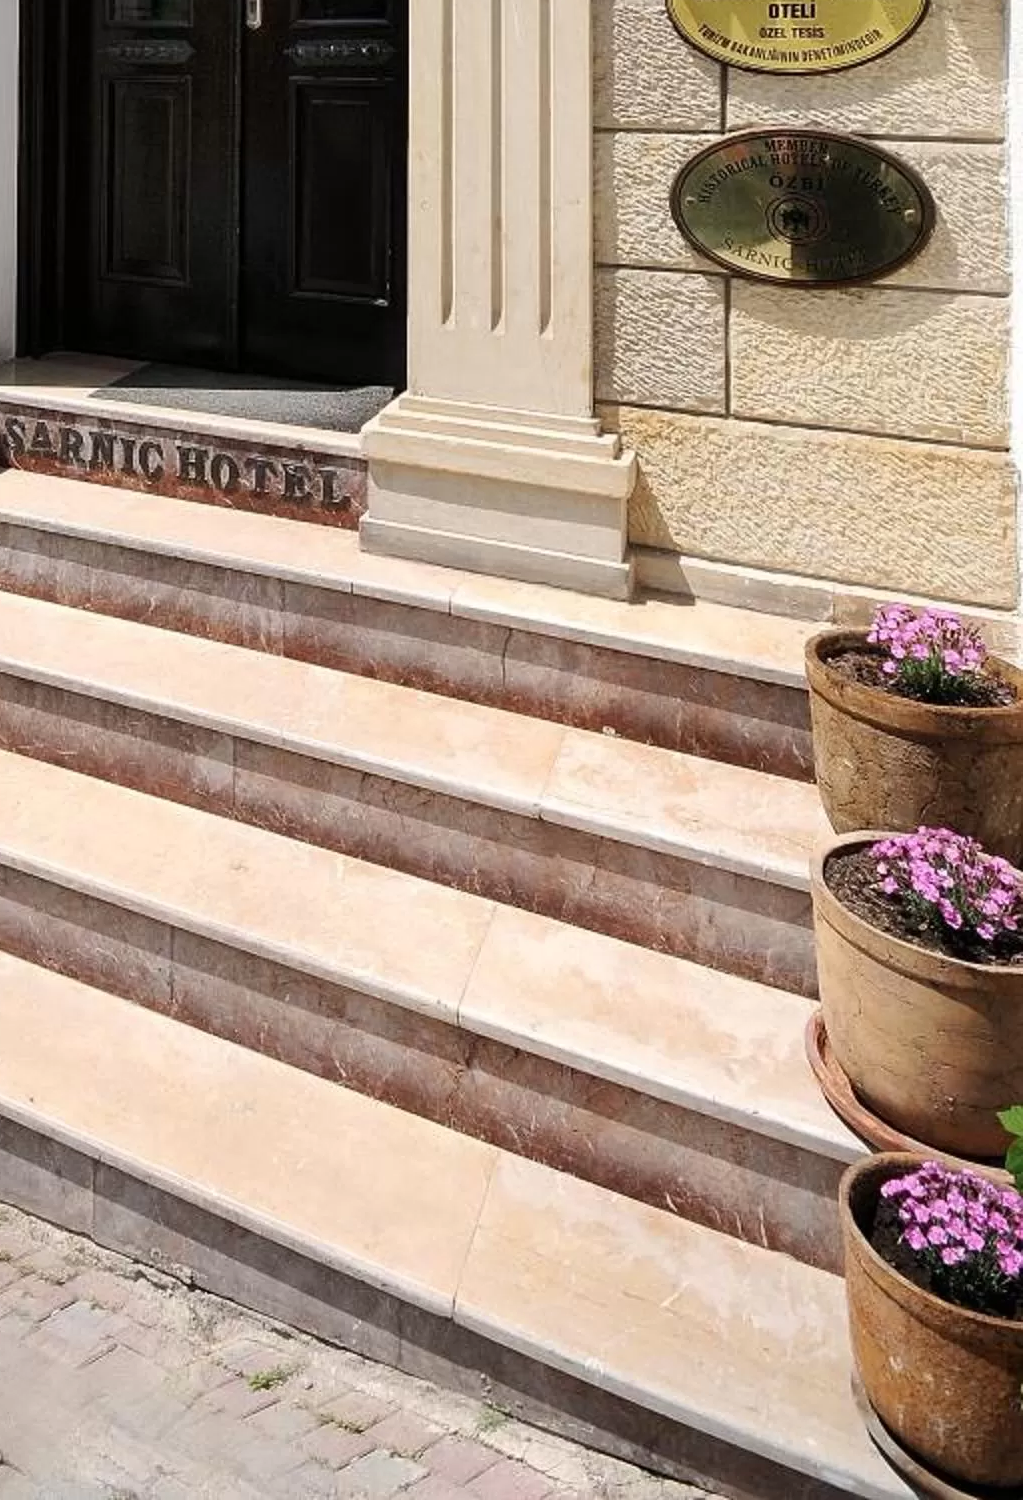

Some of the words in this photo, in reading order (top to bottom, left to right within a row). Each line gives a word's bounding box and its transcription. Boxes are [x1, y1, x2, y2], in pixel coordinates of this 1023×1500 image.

[792, 26, 825, 39] TESİS
[764, 138, 829, 154] MEMBER
[697, 153, 767, 204] HISTORICAL
[772, 152, 828, 167] HOTELS
[4, 417, 164, 482] SARNIC
[178, 447, 352, 512] HOTEL
